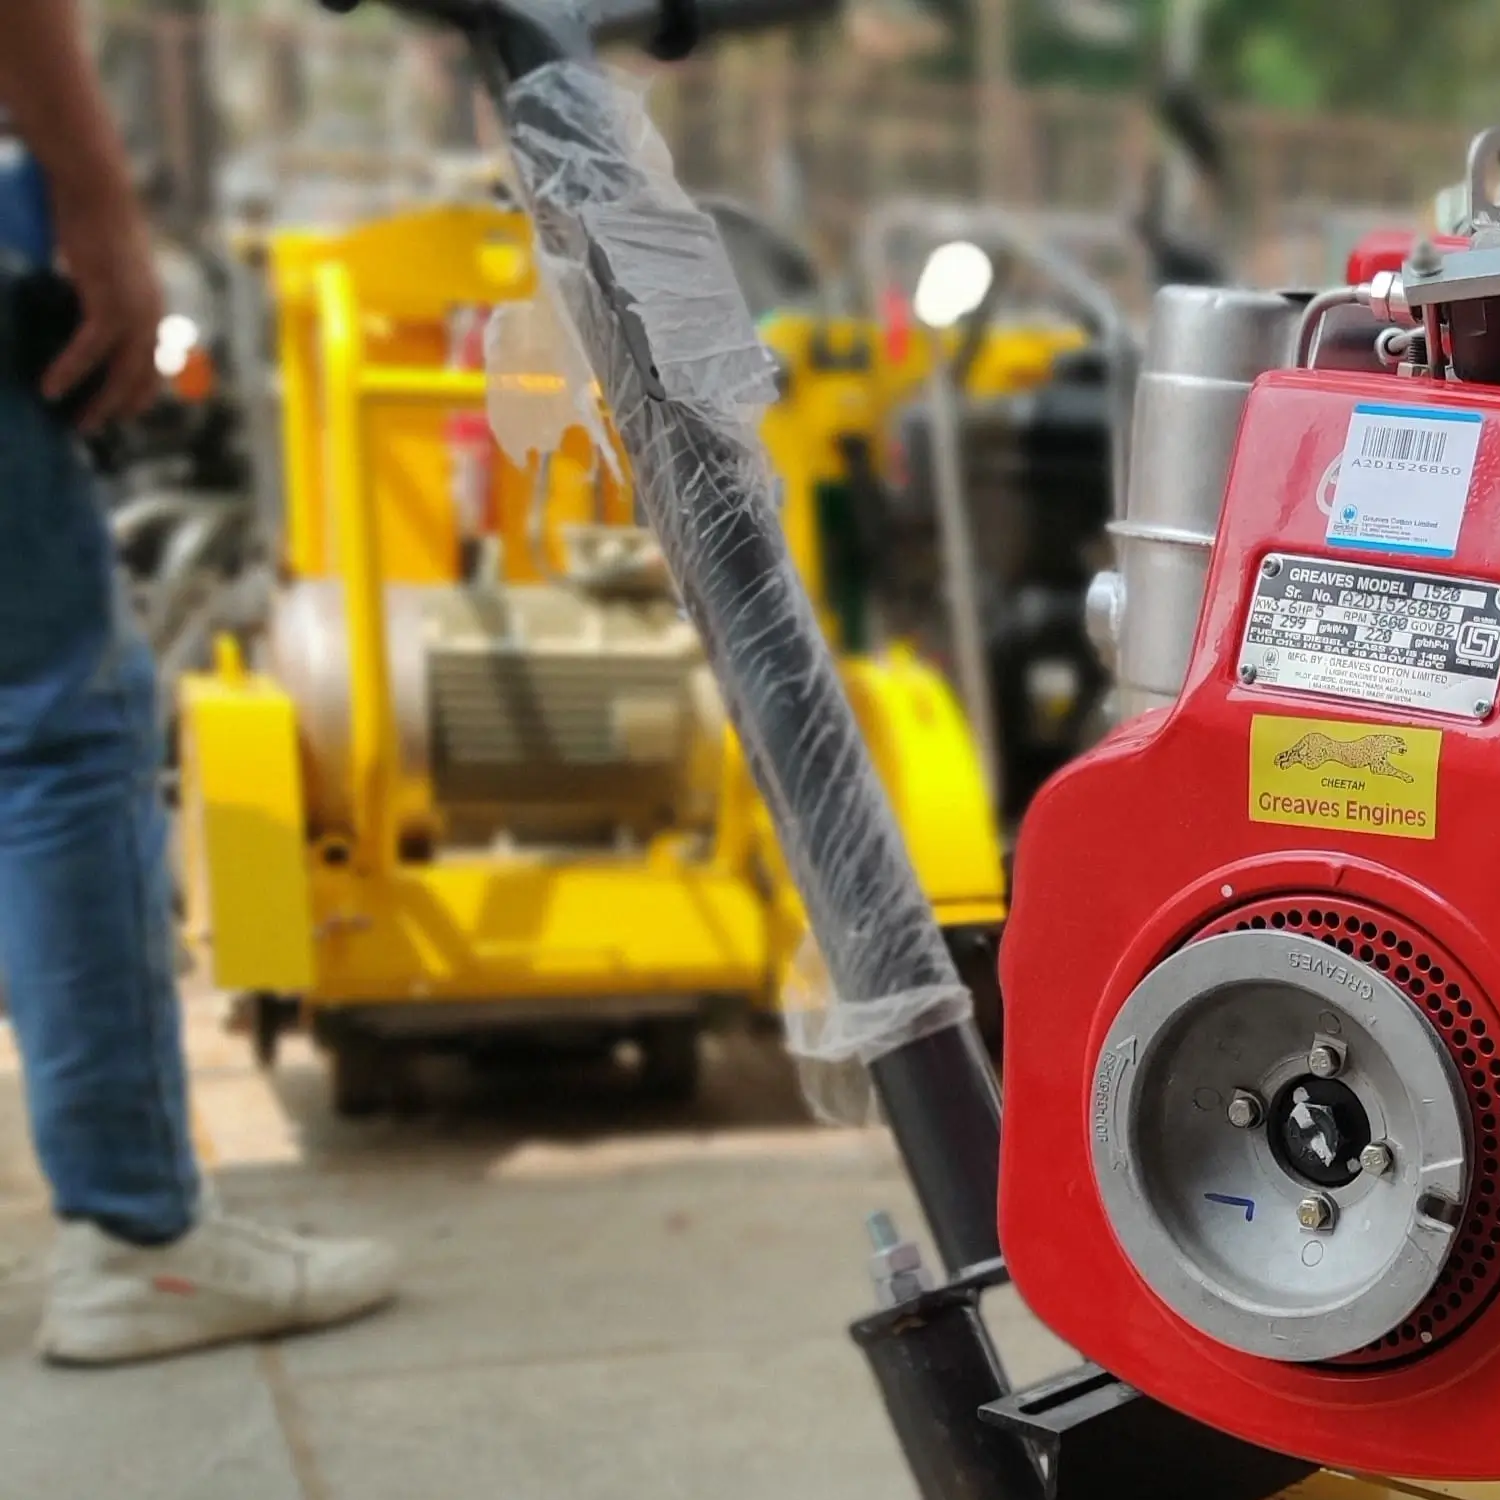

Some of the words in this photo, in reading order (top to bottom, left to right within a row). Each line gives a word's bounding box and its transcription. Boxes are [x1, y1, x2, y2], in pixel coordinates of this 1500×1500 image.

[1351, 458, 1462, 475] A2D1526850
[1289, 567, 1355, 588] GREAVES
[1357, 576, 1408, 596] MODEL
[1284, 584, 1303, 599] Sr.
[1311, 588, 1334, 603] No.
[1341, 592, 1450, 620] A2D1526850
[1279, 613, 1307, 629] 299
[1343, 611, 1368, 624] RPM
[1248, 634, 1273, 645] LUB
[1302, 642, 1321, 651] HD
[1323, 644, 1350, 655] SAE
[1369, 650, 1416, 665] ABOVE
[1302, 634, 1345, 646] DIESEL
[1346, 641, 1386, 653] CLASS
[1405, 649, 1417, 657] IS
[1329, 657, 1371, 673] GREAVES
[1372, 664, 1410, 679] COTTON
[1411, 669, 1448, 684] LIMITED
[1320, 777, 1366, 791] CHEETAH
[1258, 792, 1340, 818] Greaves
[1346, 800, 1427, 827] Engines
[1288, 950, 1374, 1001] GREAVES
